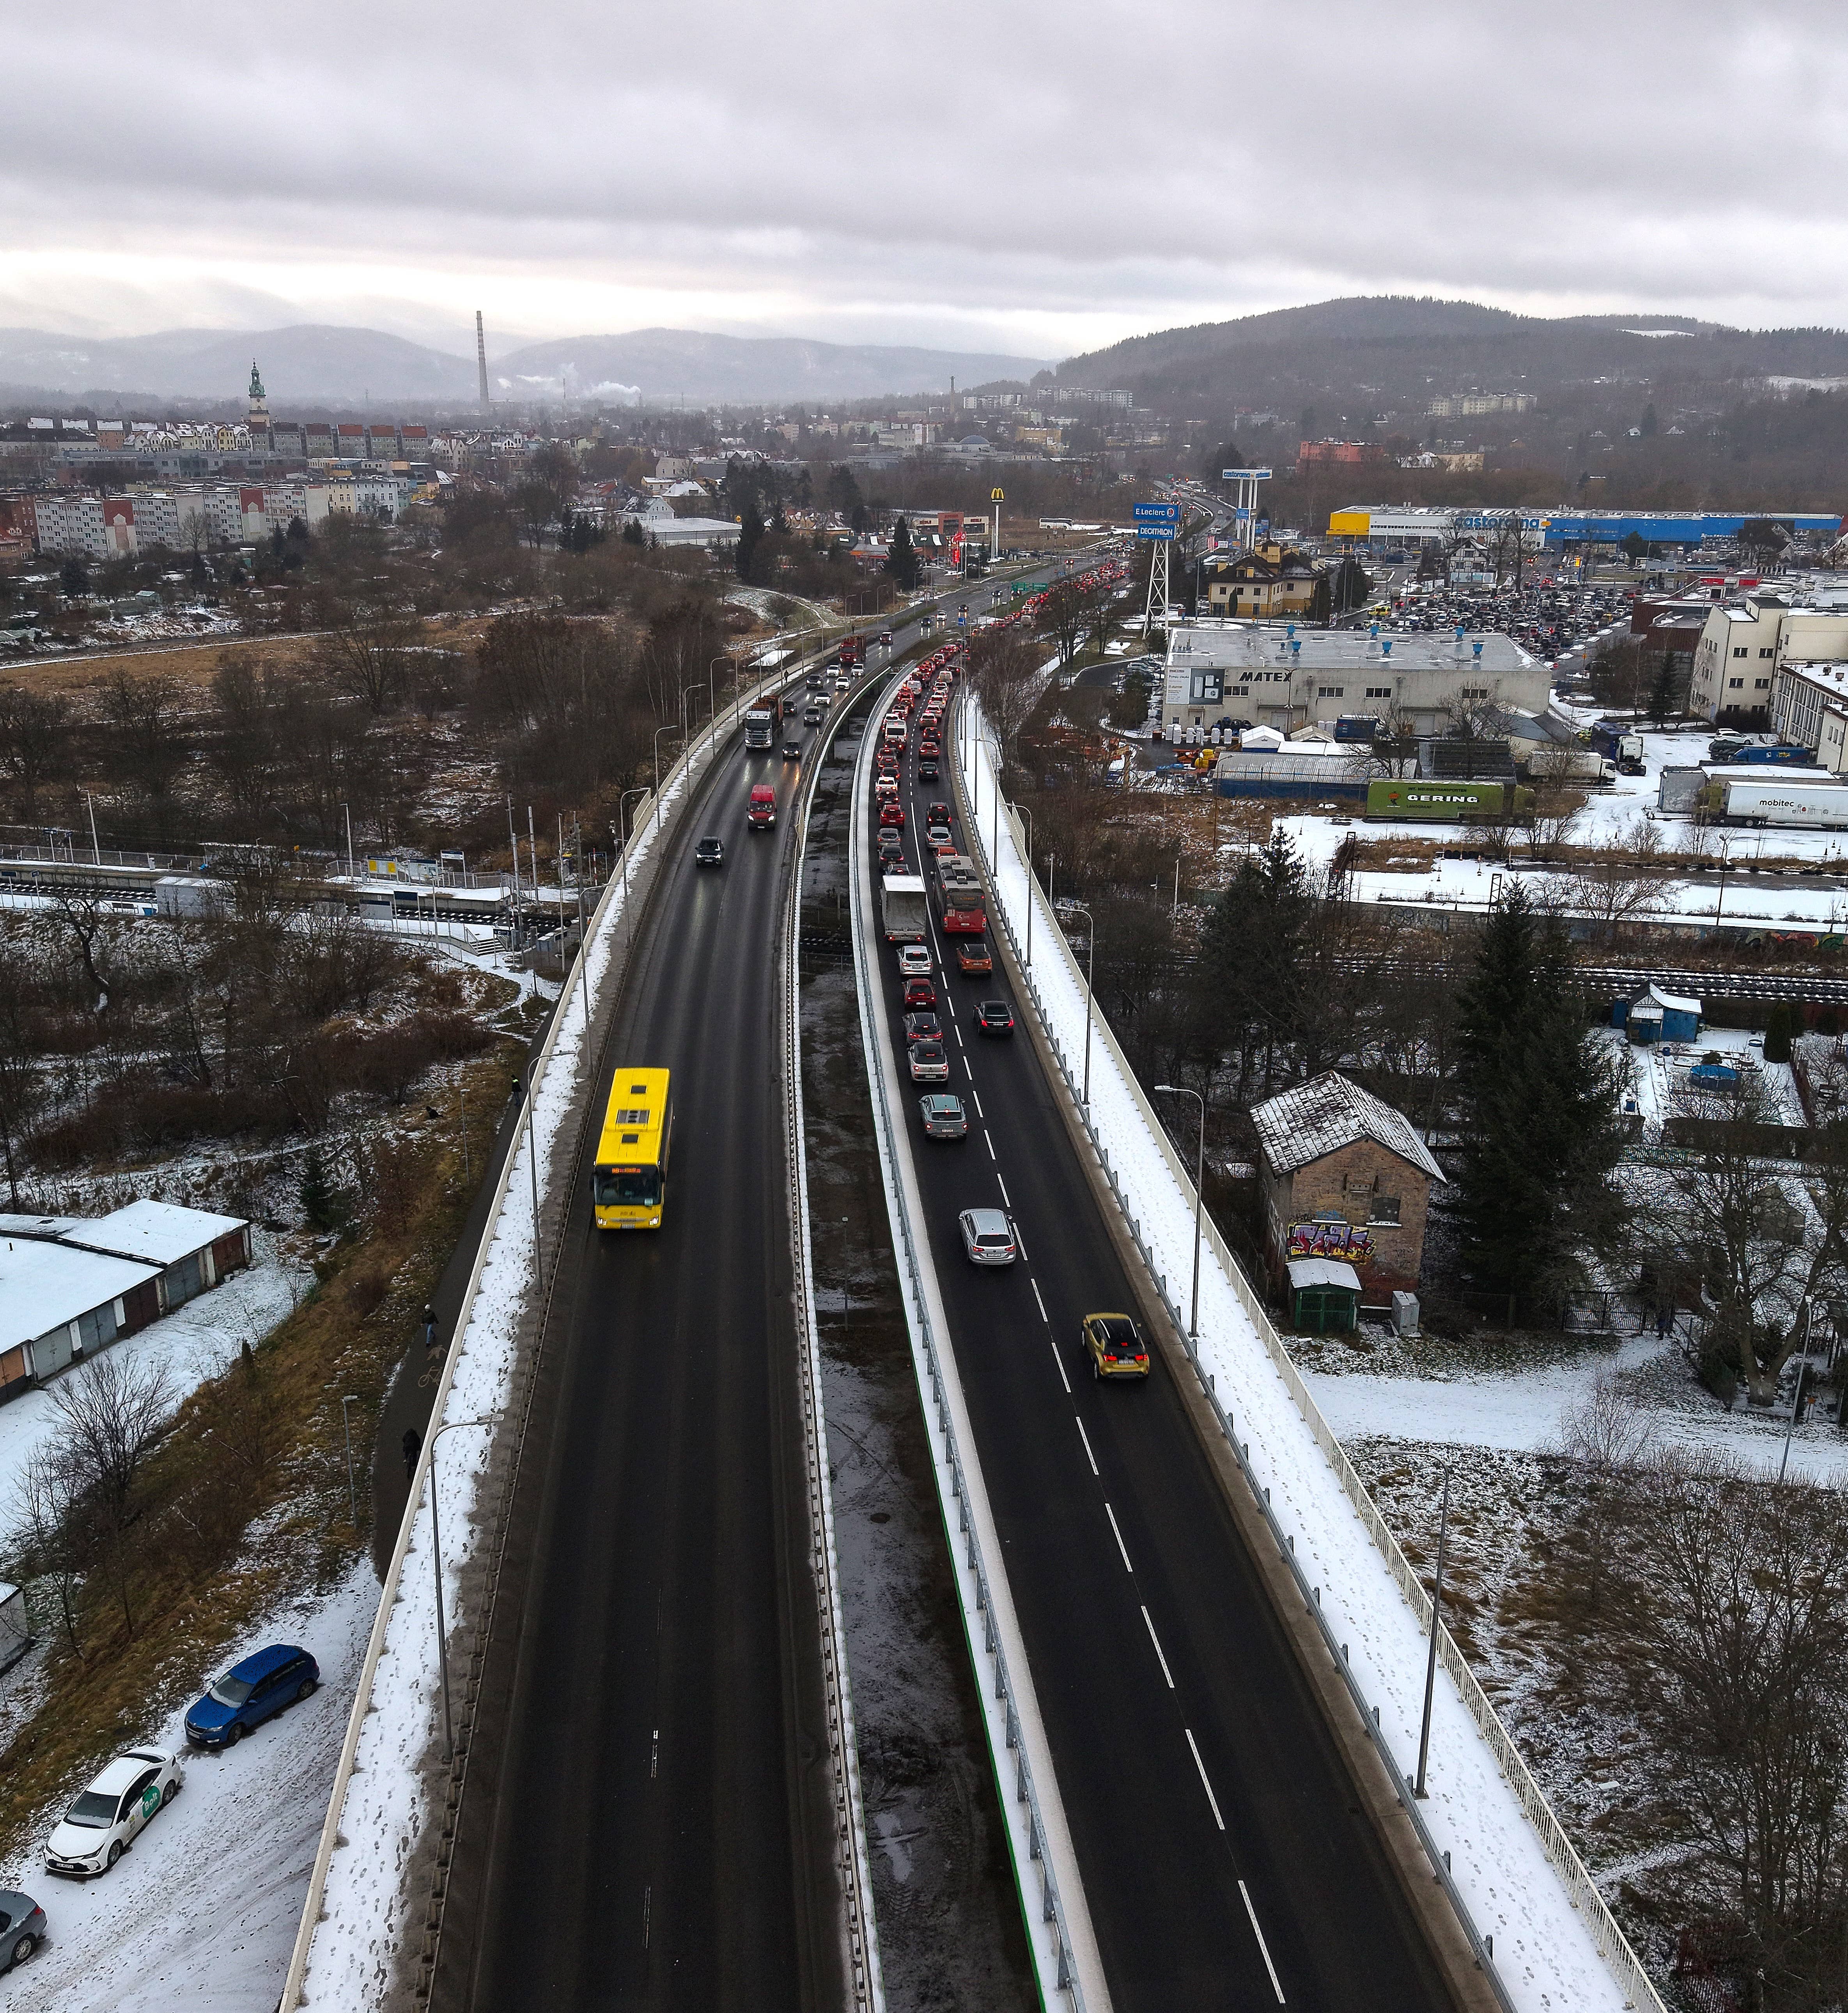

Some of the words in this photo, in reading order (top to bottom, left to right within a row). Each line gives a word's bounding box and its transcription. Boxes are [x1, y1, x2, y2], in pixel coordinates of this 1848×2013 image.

[1140, 528, 1172, 536] DECATHLON
[1239, 672, 1292, 681] MATEX
[1407, 794, 1478, 803] GERING
[144, 1792, 158, 1811] Bolt
